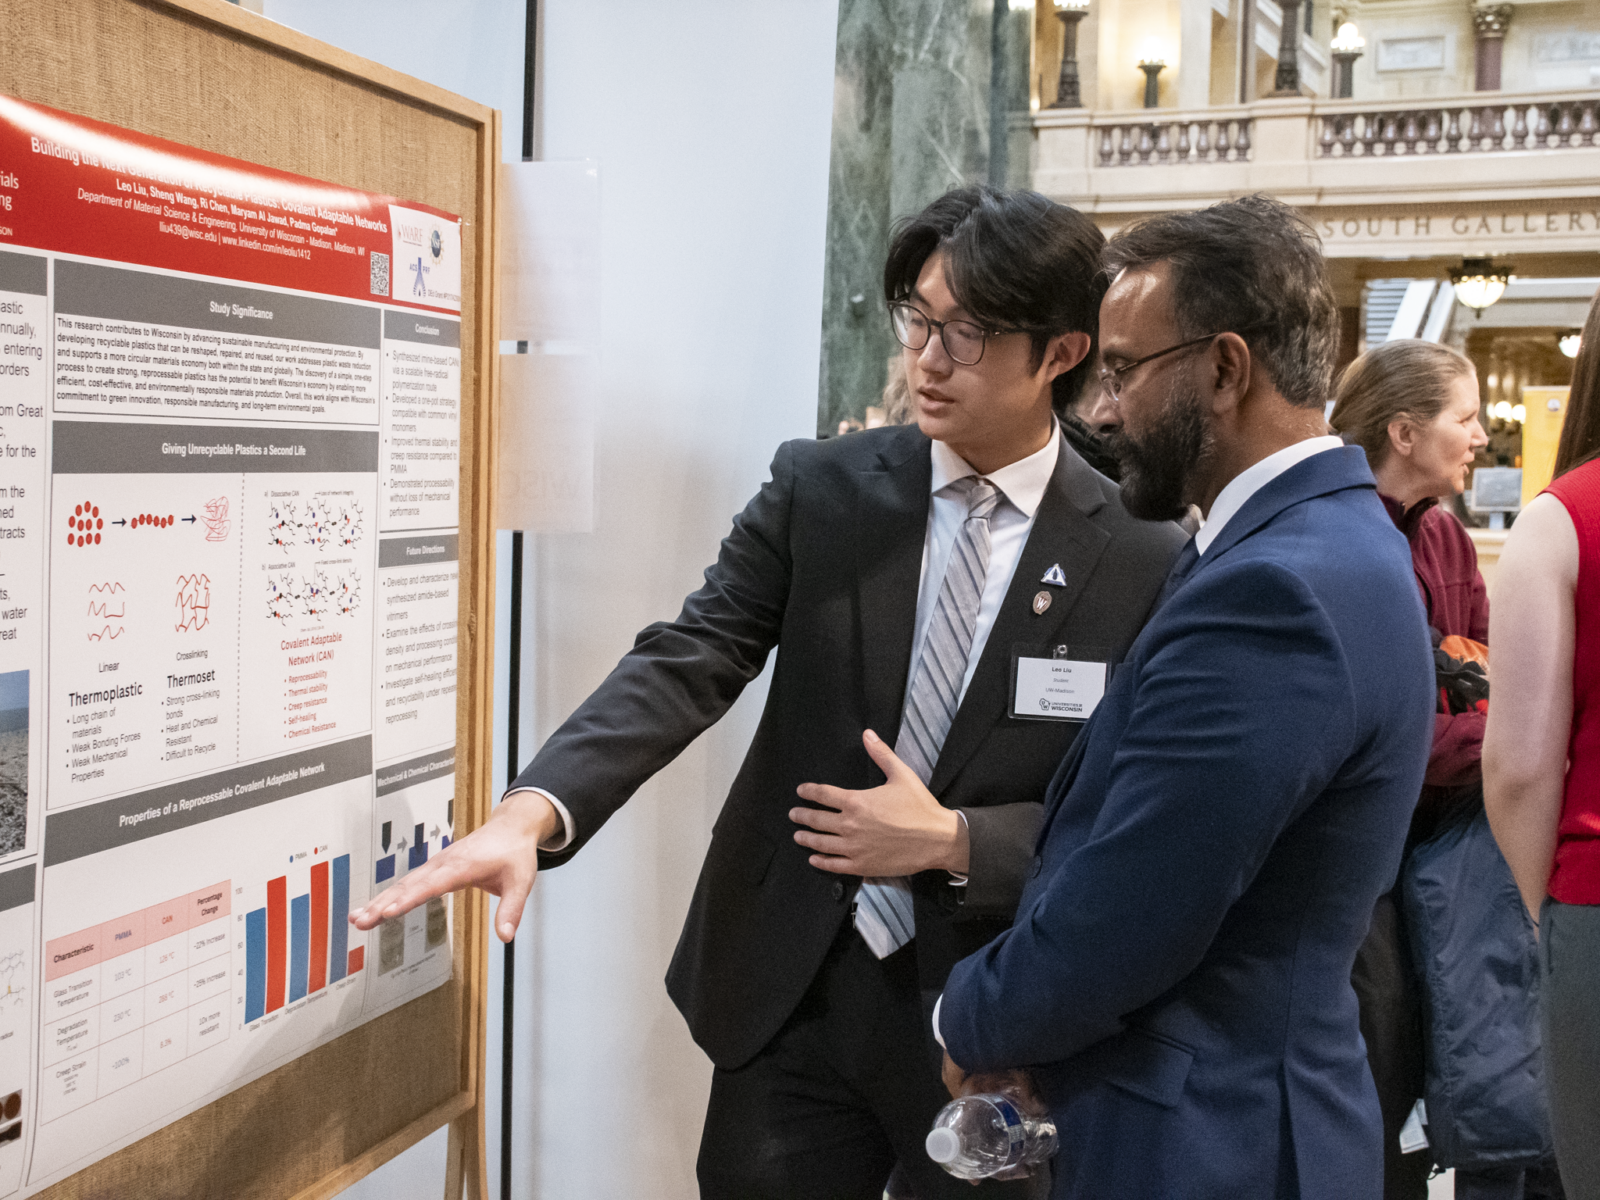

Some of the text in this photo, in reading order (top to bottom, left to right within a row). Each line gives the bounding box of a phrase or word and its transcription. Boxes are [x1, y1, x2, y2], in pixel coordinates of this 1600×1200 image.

[30, 136, 80, 166] Building
[81, 150, 99, 167] the
[102, 155, 126, 174] Next
[249, 188, 281, 211] Plastics:
[281, 197, 316, 217] Covalent
[316, 205, 354, 227] Adaptable
[355, 213, 388, 234] Networks
[116, 178, 132, 193] Leo
[133, 181, 149, 197] Liu,
[149, 186, 175, 205] Sheng
[175, 191, 200, 210] Wang,
[200, 196, 209, 208] Ri
[209, 199, 230, 215] Chen,
[230, 203, 257, 222] Maryam
[267, 212, 289, 228] Jawad,
[289, 216, 311, 232] Padma
[78, 187, 366, 257] Department of Material Science & Engineering, University of Wisconsin Madison, Madison, WI
[1321, 210, 1600, 238] SOUTH GALLERY
[401, 224, 423, 243] WARF
[209, 301, 274, 320] Study Significance
[57, 317, 364, 361] This research contributes to Wisconsin by advancing sustainable manufacturing and environmental protection. By
[4, 344, 43, 361] entering
[57, 333, 371, 371] developing recyclable plastics that can be reshaped, repaired, and reused, our work addresses plastic waste reduction
[57, 391, 127, 405] commitment to green
[17, 403, 44, 418] Great
[6, 444, 37, 459] for the
[161, 442, 307, 458] Giving Unrecyclable Plastics a Second Life
[10, 485, 26, 498] the
[406, 544, 446, 556] Future Directions
[1037, 597, 1048, 610] W
[1, 607, 28, 620] water
[280, 632, 343, 651] Covalent Adaptable
[176, 649, 208, 662] Crosslinking
[288, 650, 335, 667] Network (CAN)
[98, 661, 120, 674] Linear
[167, 669, 216, 689] Thermoset
[288, 669, 328, 684] Reprocessability
[69, 682, 143, 708] Thermoplastic
[166, 688, 221, 707] Strong cross-linking
[288, 682, 328, 698] Thermal stability
[288, 696, 328, 712] Creep resistance
[72, 707, 116, 725] Long chain of
[166, 709, 183, 720] bonds
[288, 712, 317, 725] Self-healing
[72, 725, 102, 739] materials
[166, 715, 218, 734] Heat and Chemical
[288, 722, 337, 739] Chemical Resistance
[71, 731, 141, 754] Weak Bonding Forces
[166, 734, 192, 748] Resistant
[71, 748, 128, 768] Weak Mechanical
[165, 742, 216, 762] Difficult to Recycle
[71, 768, 105, 783] Properties
[119, 762, 325, 828] Properties of a Reprocessable Covalent Adaptable Network
[197, 892, 223, 906] Percentage
[201, 905, 219, 917] Change
[161, 915, 174, 925] CAN
[114, 929, 132, 941] PMMA
[53, 942, 95, 963] Characteristic
[53, 978, 93, 999] Glass Transition
[57, 990, 90, 1008] Temperature
[57, 1018, 88, 1036] Degradation
[56, 1029, 89, 1047] Temperature
[55, 1067, 71, 1079] Creep
